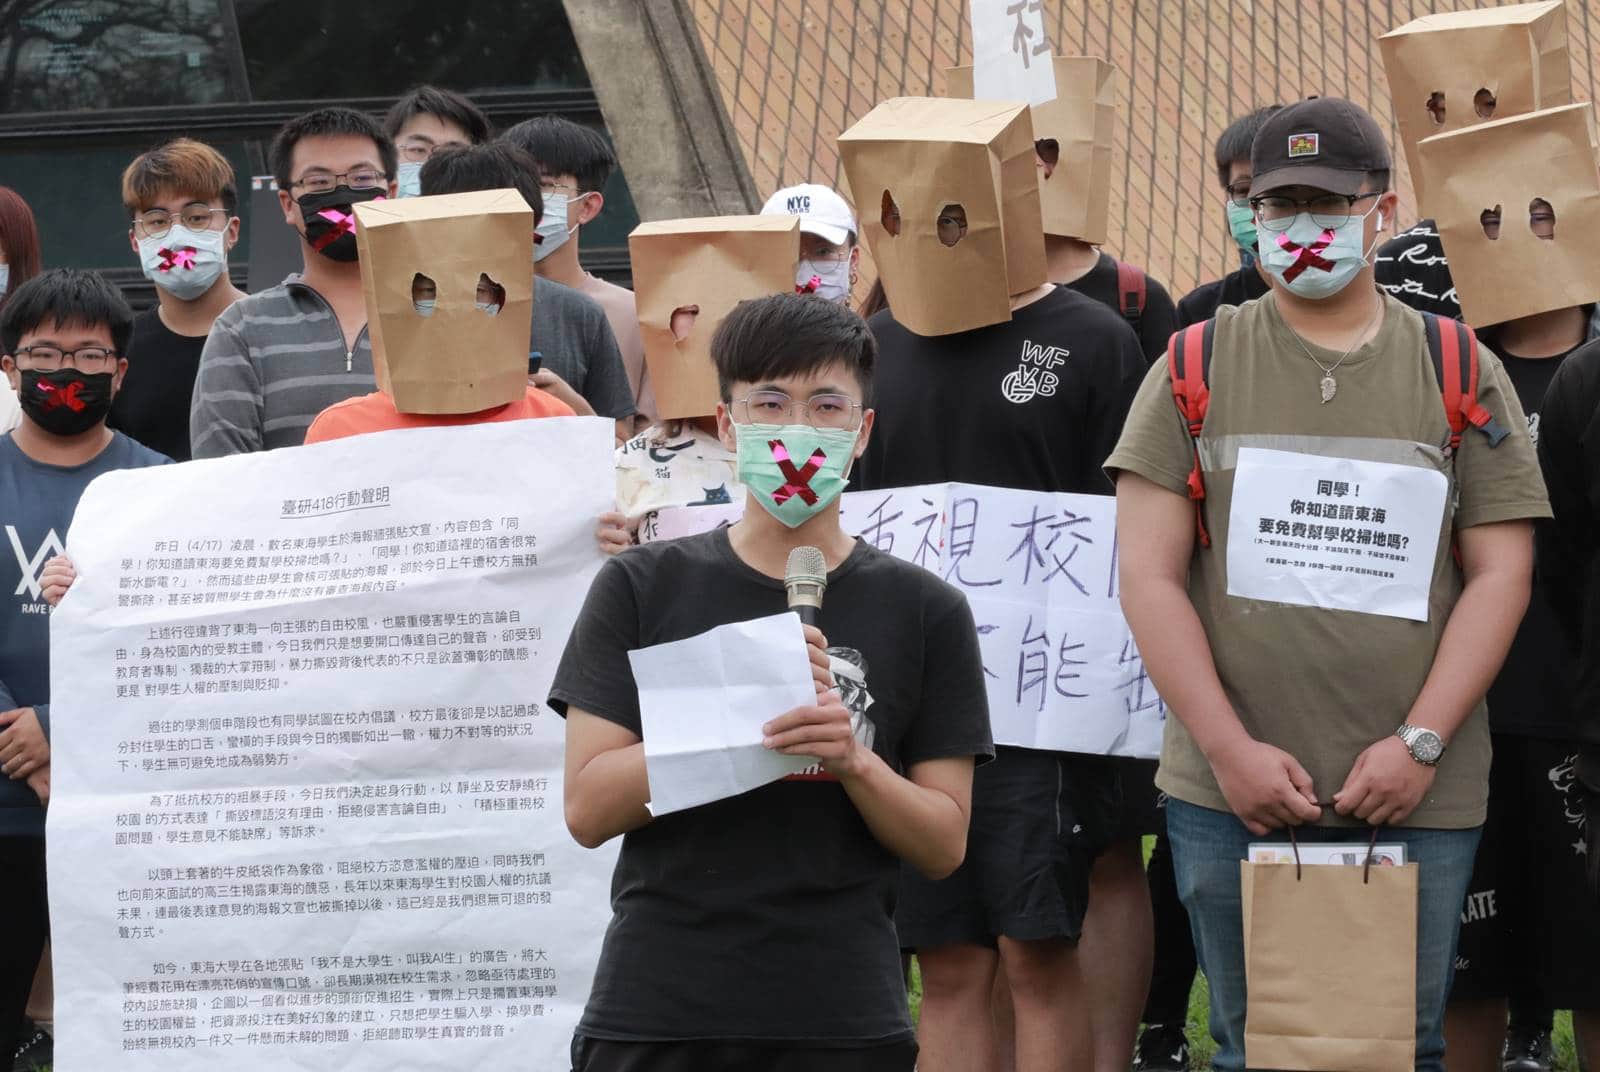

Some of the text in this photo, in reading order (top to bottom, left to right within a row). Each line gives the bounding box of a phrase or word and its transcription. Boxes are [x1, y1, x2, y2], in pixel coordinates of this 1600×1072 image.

[787, 195, 811, 211] NYC
[1021, 339, 1070, 370] WF
[1290, 500, 1387, 524] 你知道讀東海
[1258, 517, 1410, 550] 要免費幫學校掃地嗎?
[858, 494, 1118, 598] 重視校
[22, 604, 47, 614] RAVE
[118, 925, 164, 940] 聲方式。
